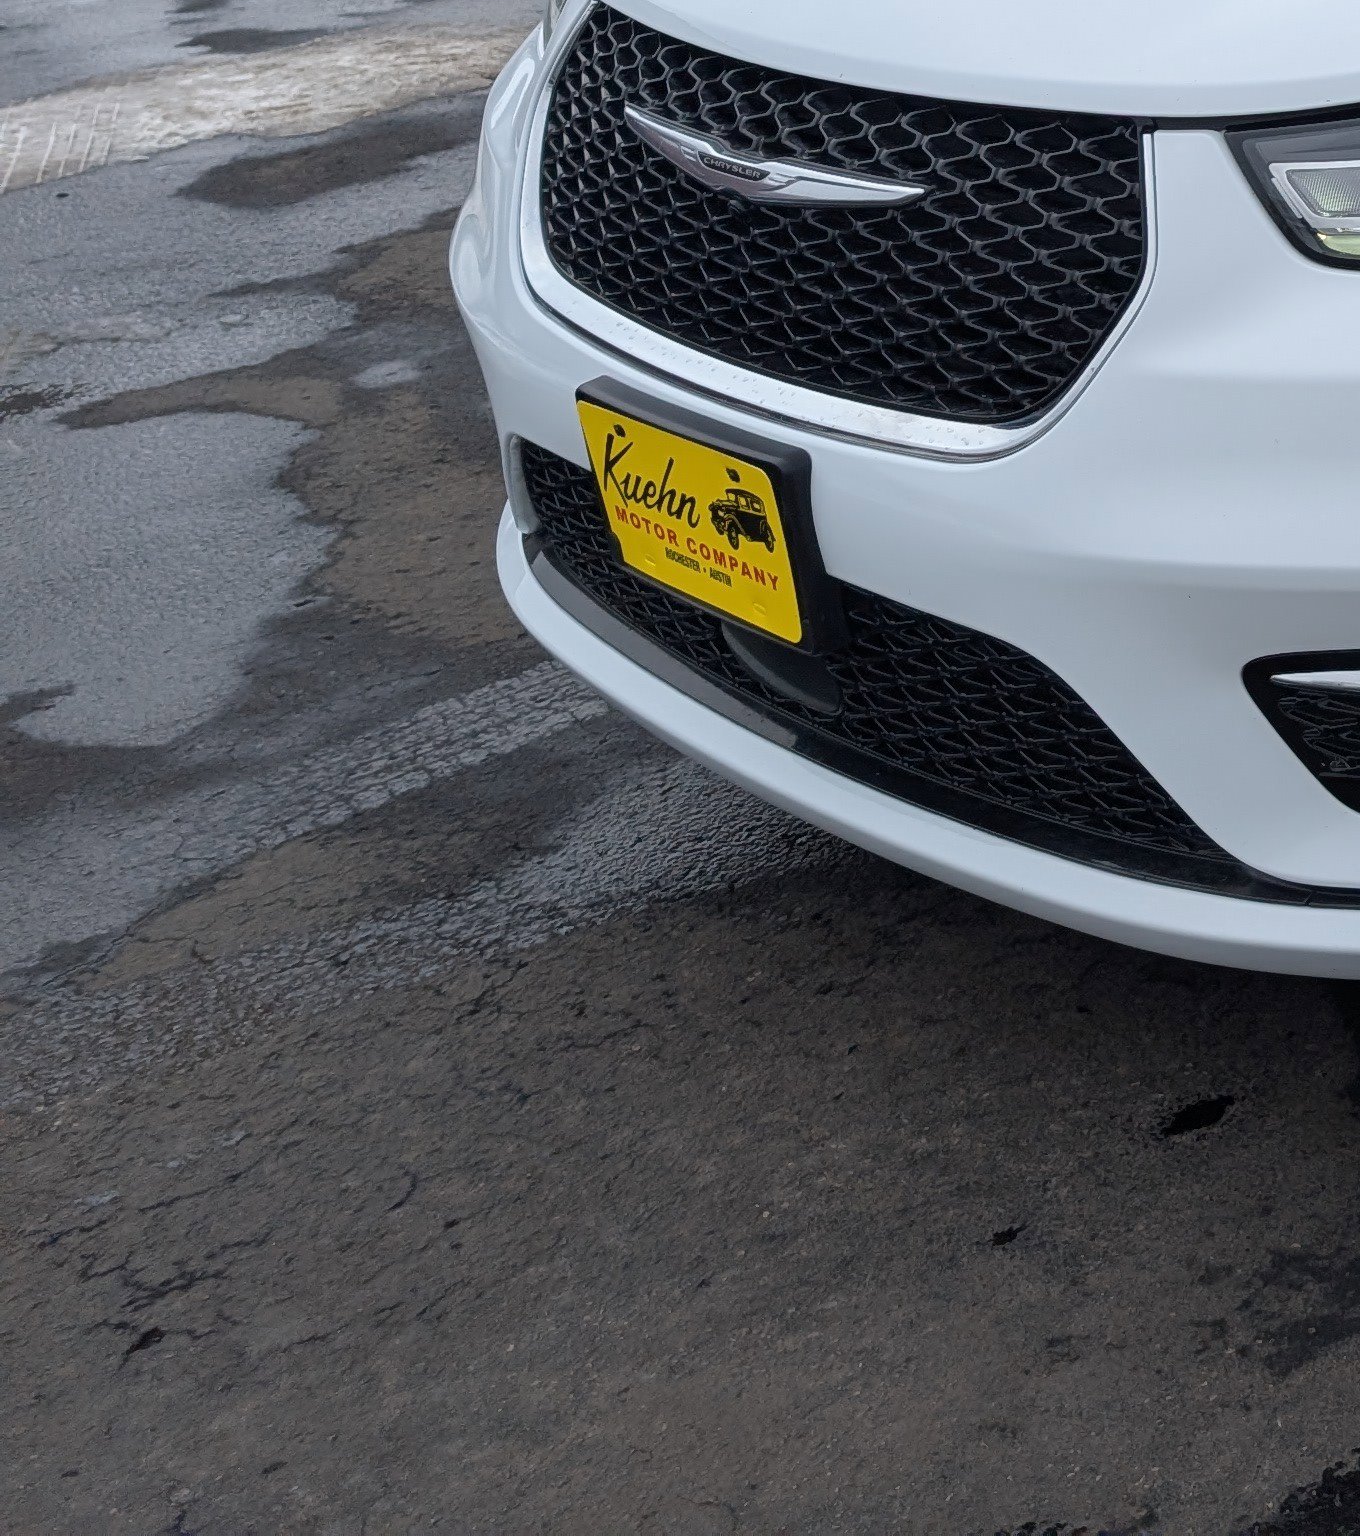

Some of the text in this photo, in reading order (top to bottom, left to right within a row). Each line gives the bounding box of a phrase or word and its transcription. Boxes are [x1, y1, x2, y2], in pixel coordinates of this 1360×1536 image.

[703, 157, 762, 179] CHRYSLER
[603, 432, 700, 529] Kuehn
[615, 504, 779, 591] MOTOR COMPANY
